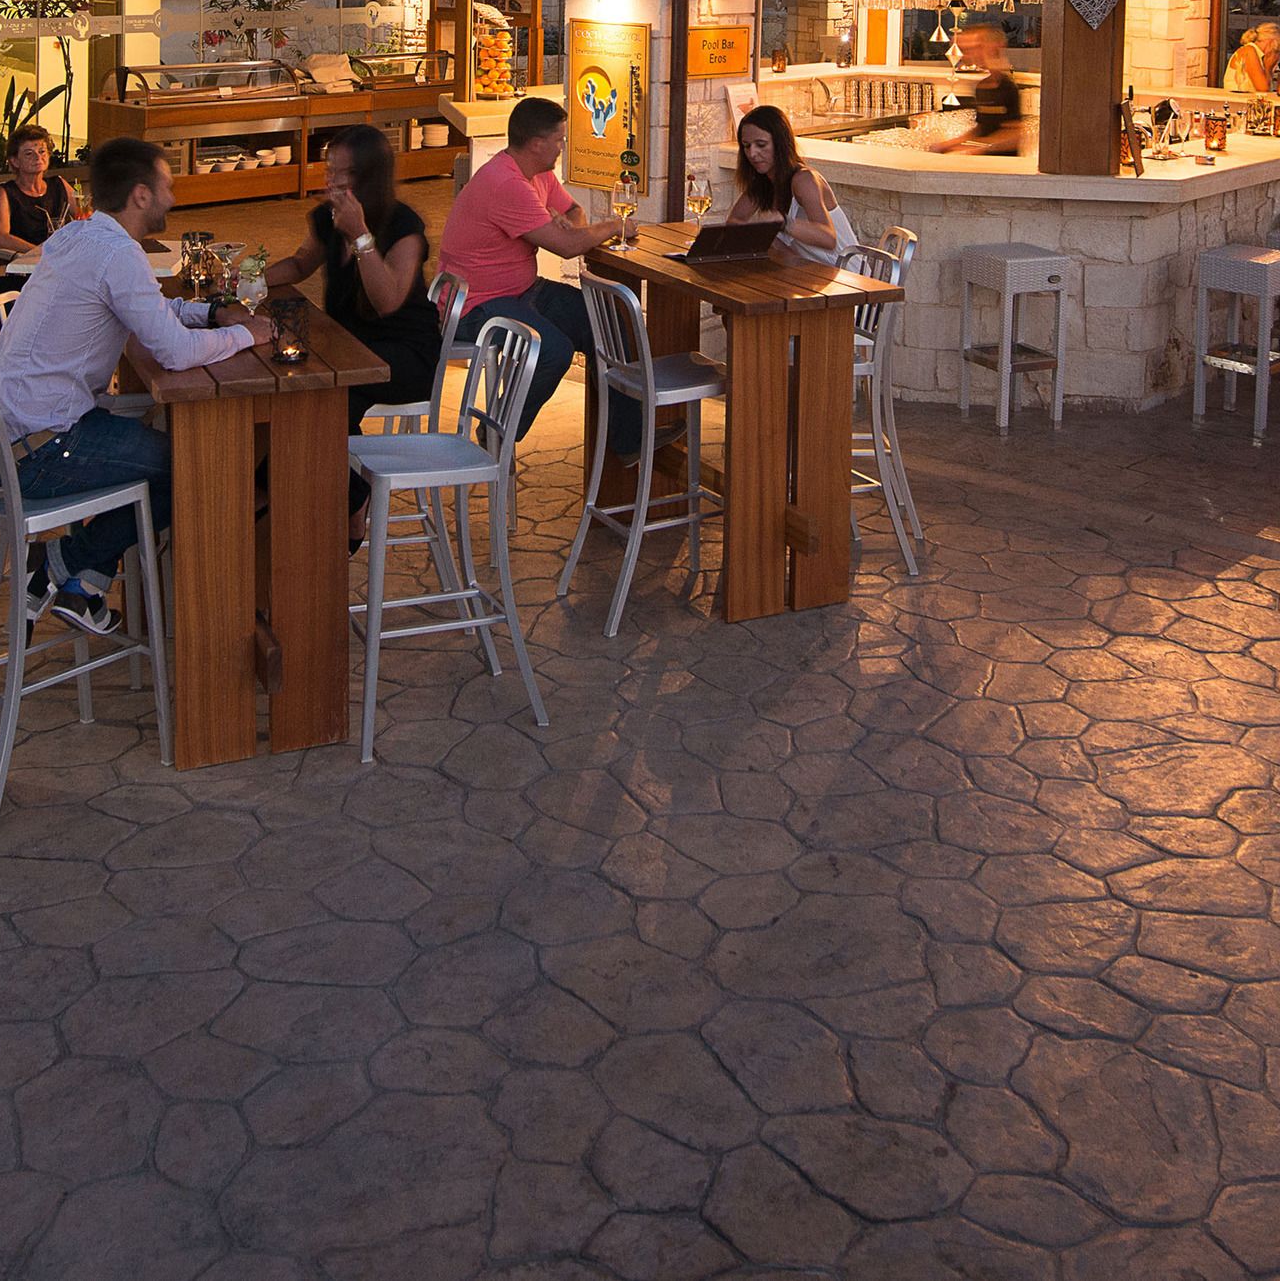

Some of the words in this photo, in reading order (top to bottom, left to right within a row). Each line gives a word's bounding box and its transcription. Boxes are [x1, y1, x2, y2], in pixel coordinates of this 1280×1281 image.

[702, 39, 719, 50] Pool
[721, 39, 735, 49] Bar
[709, 53, 727, 64] Eros
